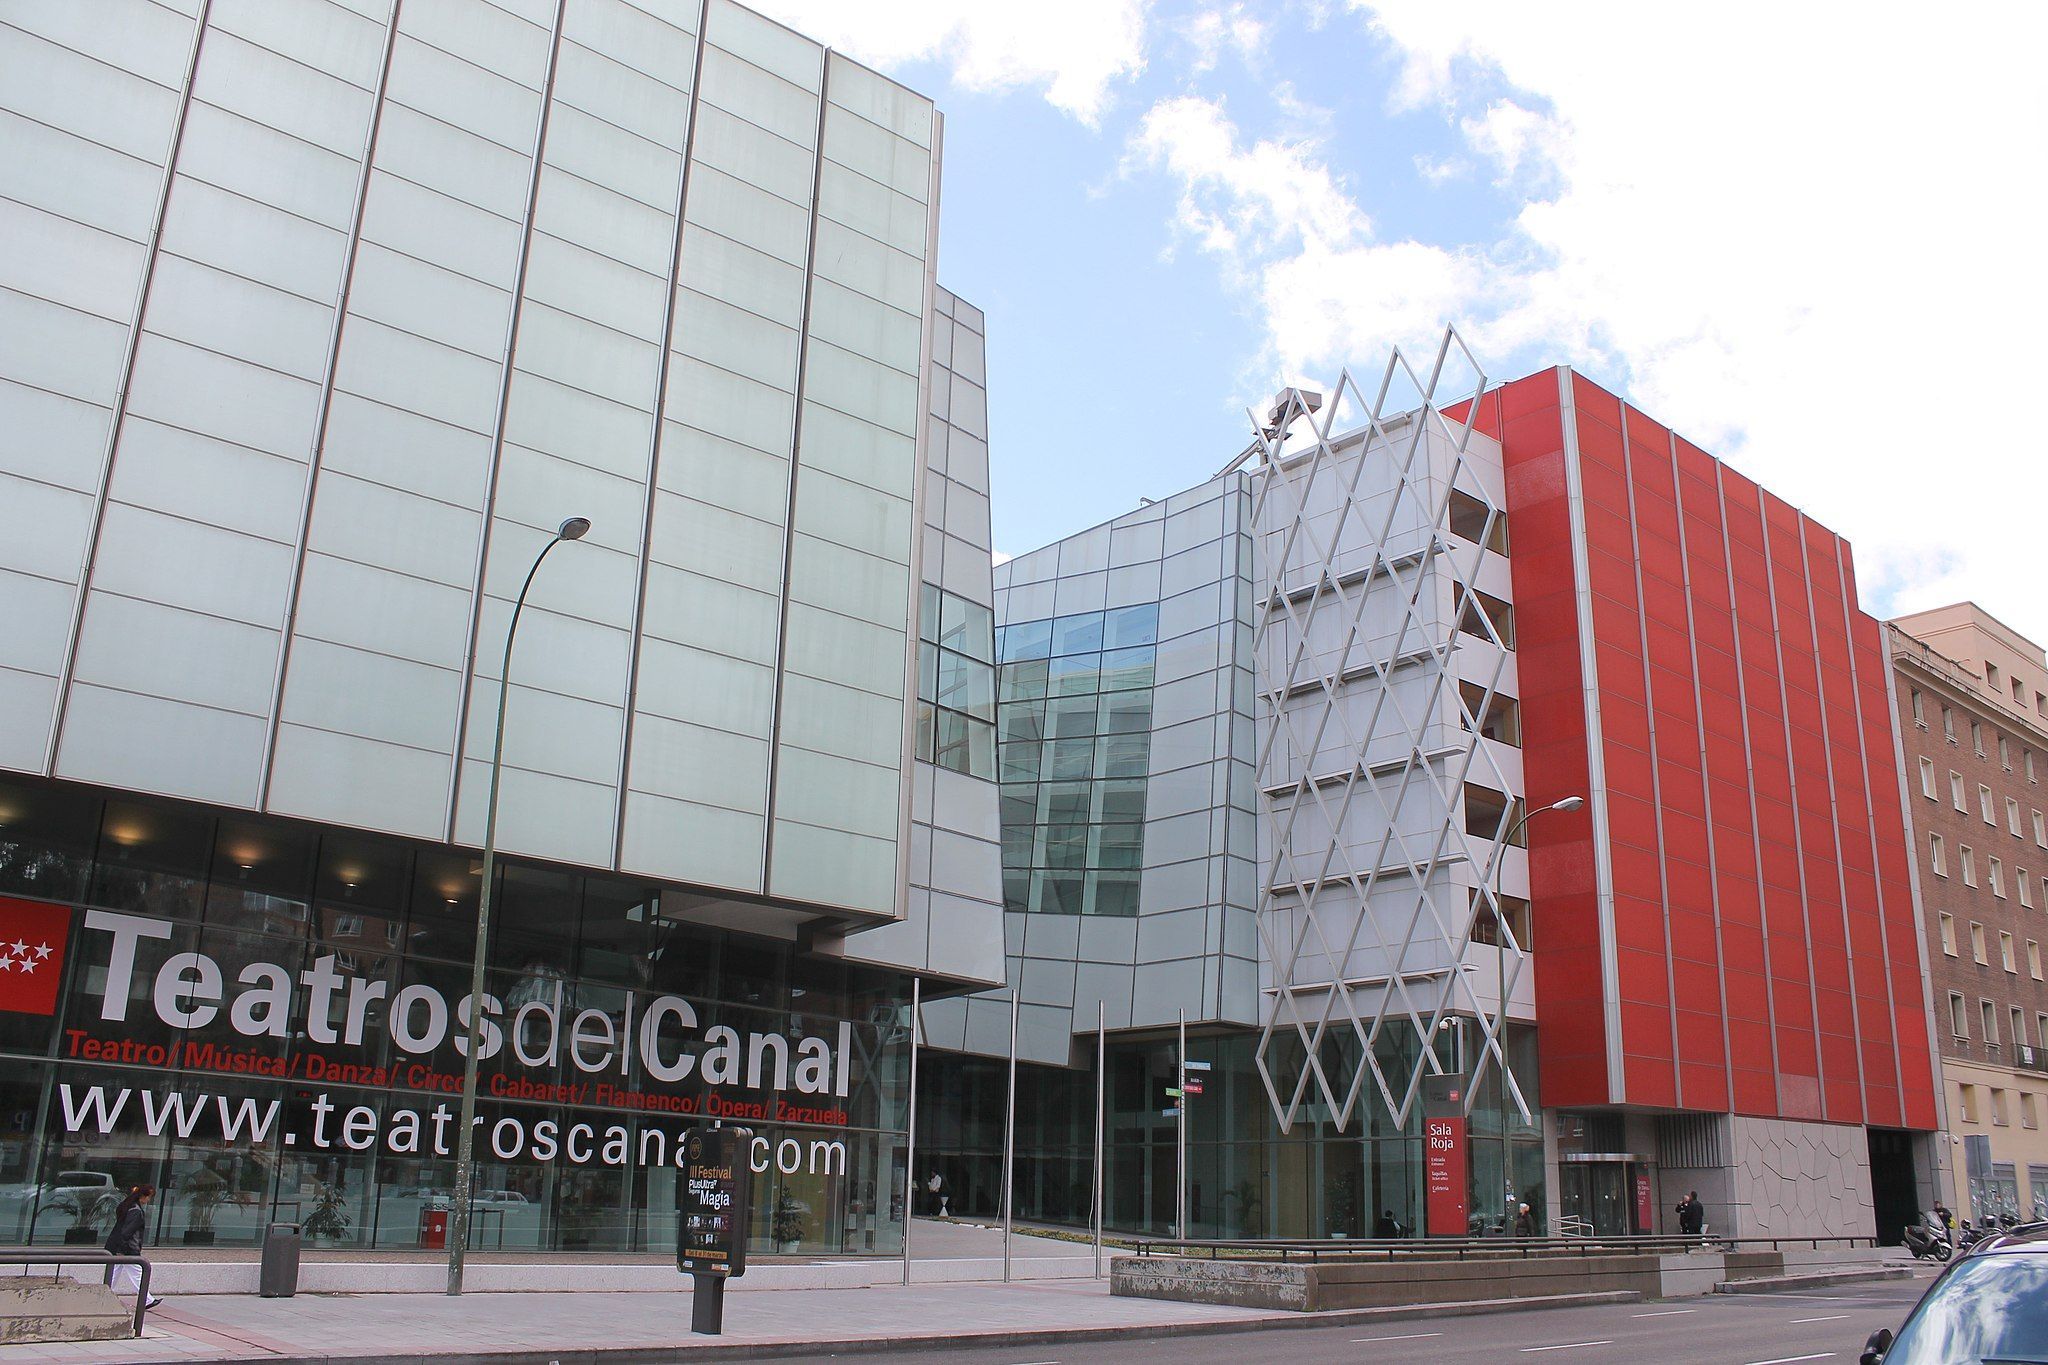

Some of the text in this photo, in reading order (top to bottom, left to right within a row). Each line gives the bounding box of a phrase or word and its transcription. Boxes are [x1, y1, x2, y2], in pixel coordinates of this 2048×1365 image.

[775, 1102, 848, 1126] Zarzuela
[1430, 1123, 1452, 1136] Sala
[1431, 1137, 1454, 1151] Roja
[698, 1165, 732, 1179] Festival
[699, 1190, 730, 1210] Magia
